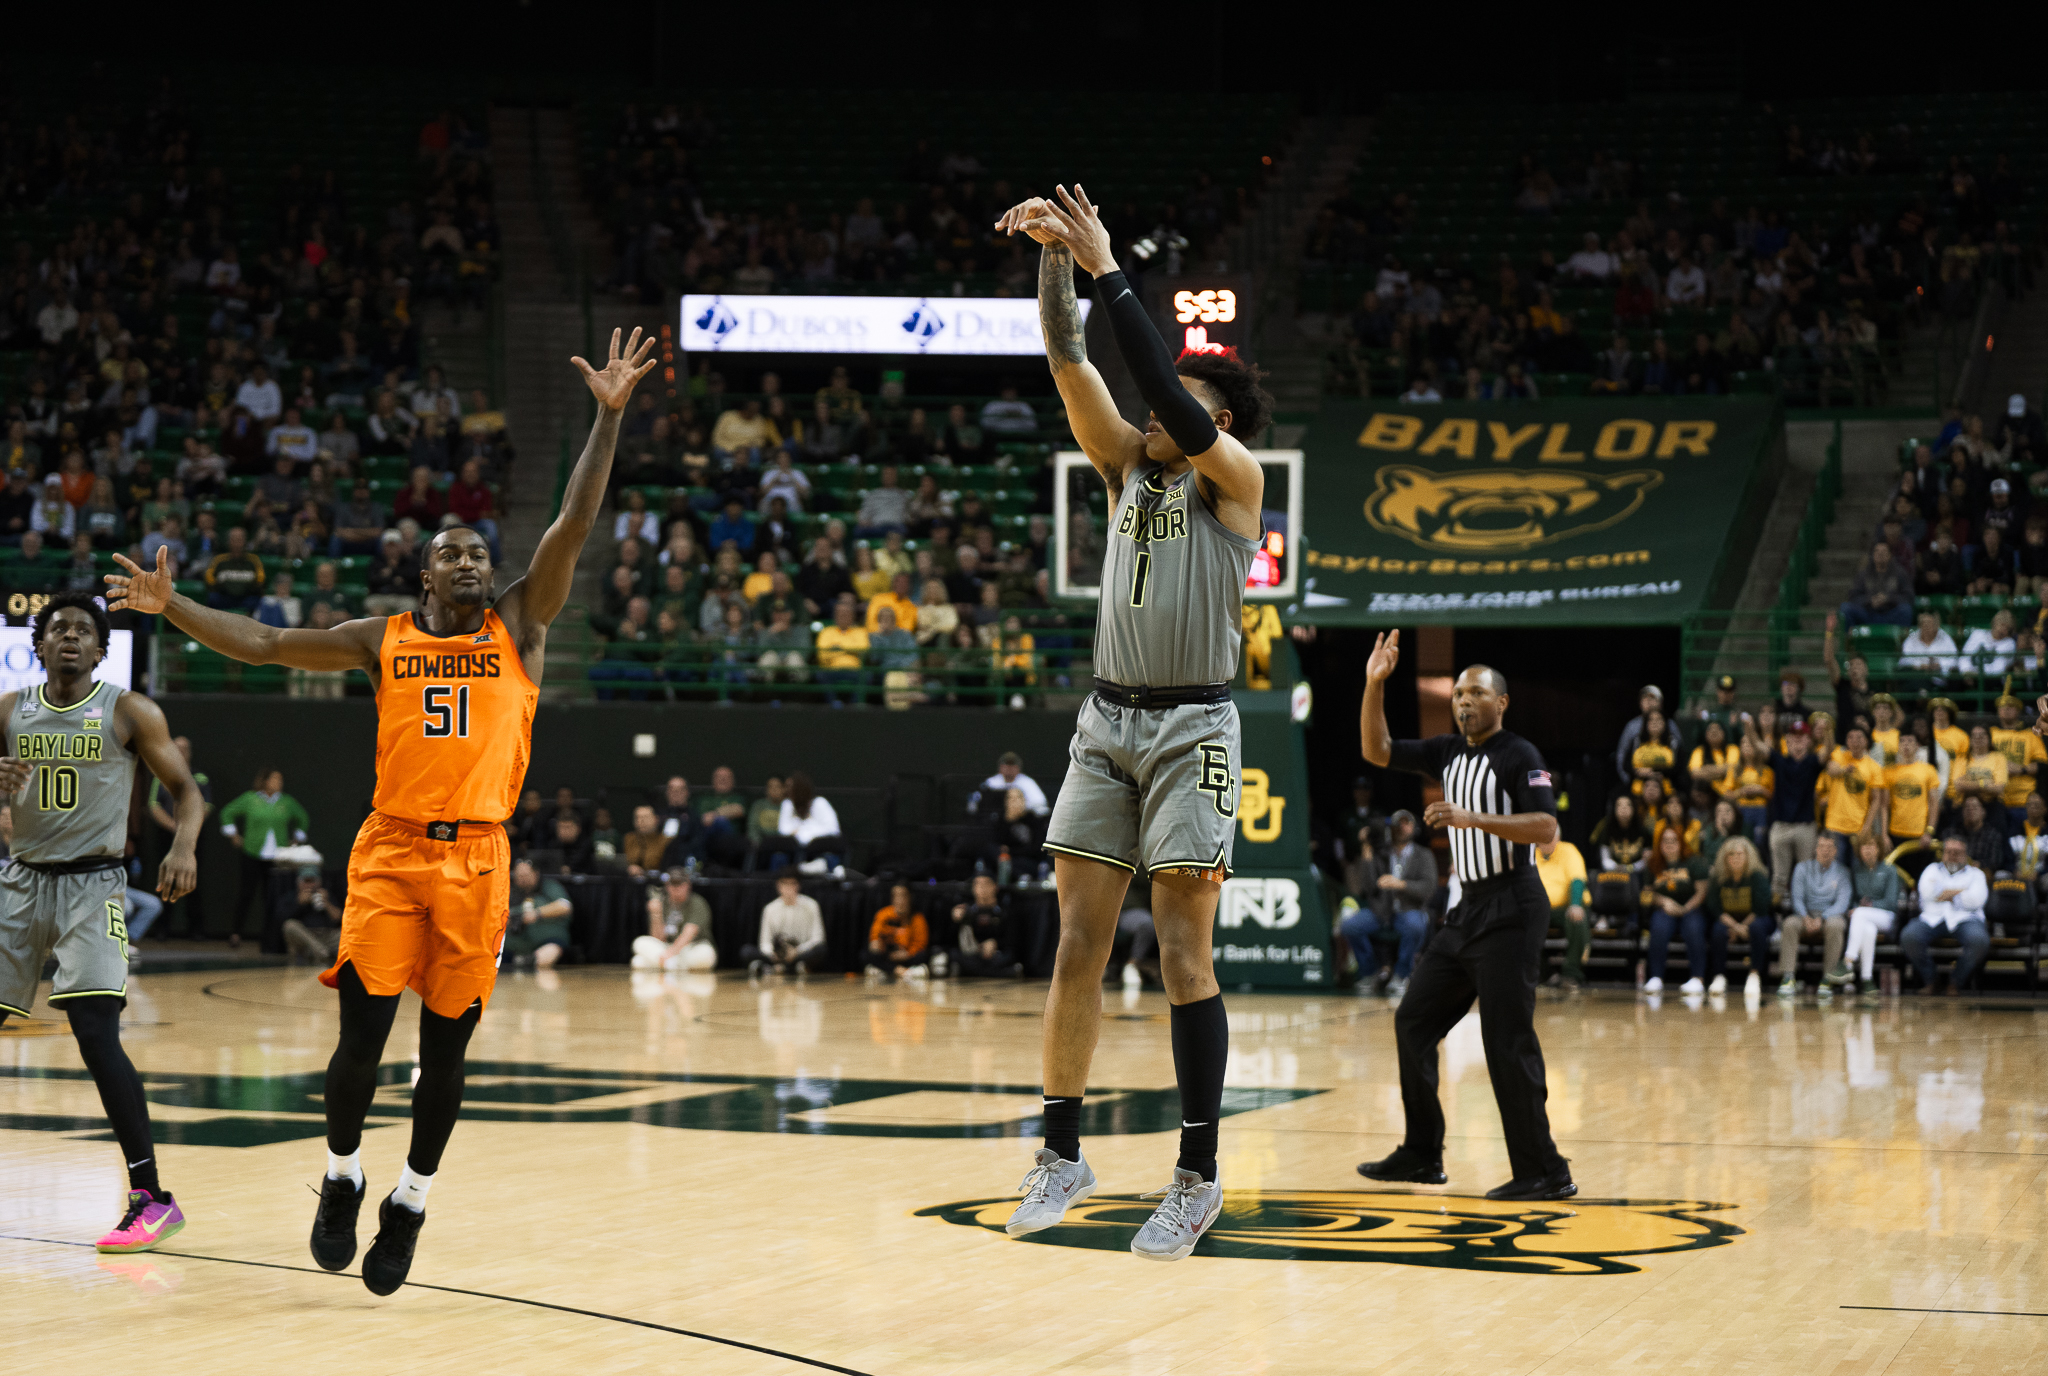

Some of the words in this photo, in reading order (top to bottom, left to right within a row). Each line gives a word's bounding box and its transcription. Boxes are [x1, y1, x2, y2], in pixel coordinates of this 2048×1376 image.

[1358, 413, 1717, 462] BAYLOR
[1117, 503, 1188, 544] BYOR
[1130, 551, 1151, 608] 1
[1558, 580, 1682, 600] BUREAU
[393, 653, 501, 680] COWBOYS
[422, 685, 470, 738] 51
[17, 732, 103, 761] BAYLOR
[39, 765, 79, 811] 10
[1197, 743, 1235, 819] BU
[1223, 944, 1265, 963] Bank
[1266, 944, 1290, 963] for
[1291, 945, 1323, 964] Life
